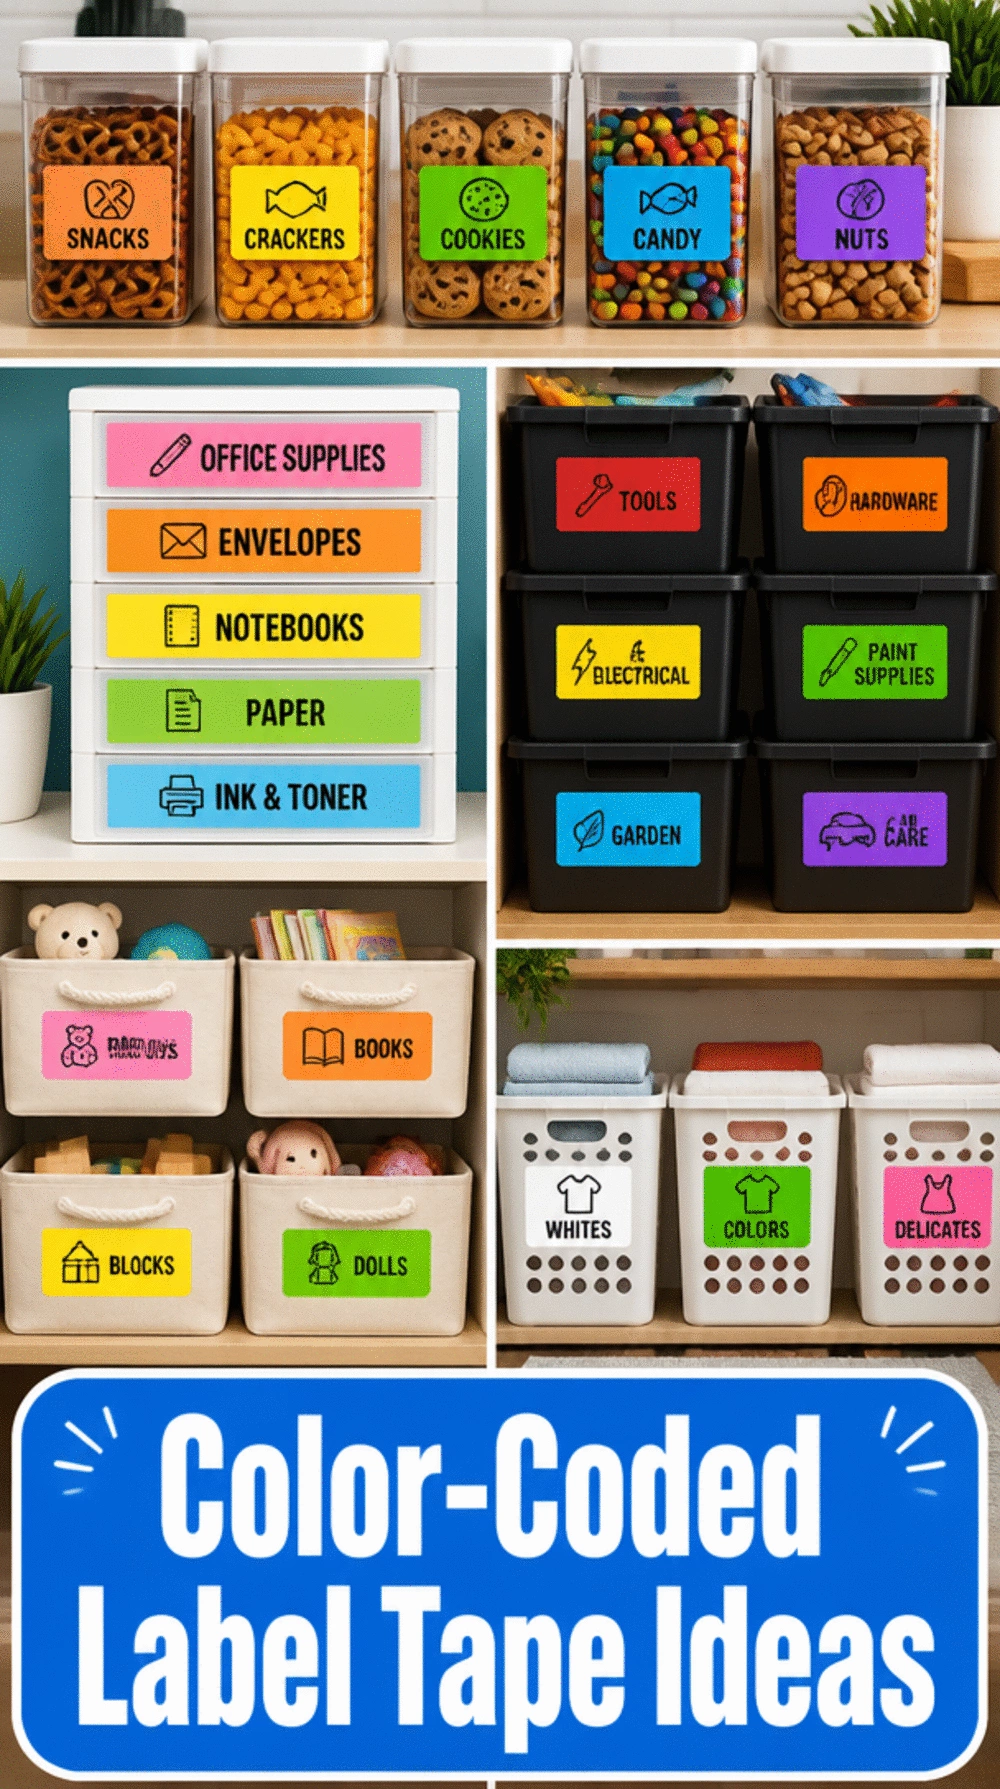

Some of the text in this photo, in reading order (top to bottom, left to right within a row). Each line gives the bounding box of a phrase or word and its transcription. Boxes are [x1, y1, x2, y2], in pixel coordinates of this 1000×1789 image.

[68, 228, 150, 250] SNACKS
[245, 228, 346, 251] CRACKERS
[441, 229, 527, 251] COOKIES
[632, 228, 702, 250] CANDY
[835, 228, 889, 251] NUTS
[201, 444, 386, 473] OFFICE SUPPLIES
[619, 491, 678, 512] TOOLS
[219, 528, 362, 557] ENVELOPES
[216, 613, 364, 642] NOTEBOOKS
[868, 643, 918, 662] PAINT
[855, 667, 935, 687] SUPPLIES
[246, 699, 326, 728] PAPER
[215, 784, 368, 812] INK & TONER
[611, 825, 682, 847] GARDEN
[354, 1038, 414, 1060] BOOKS
[545, 1219, 612, 1240] WHITES
[723, 1219, 790, 1240] COLORS
[894, 1219, 982, 1240] DELICATES
[109, 1255, 175, 1276] BLOCKS
[354, 1256, 408, 1277] DOLLS
